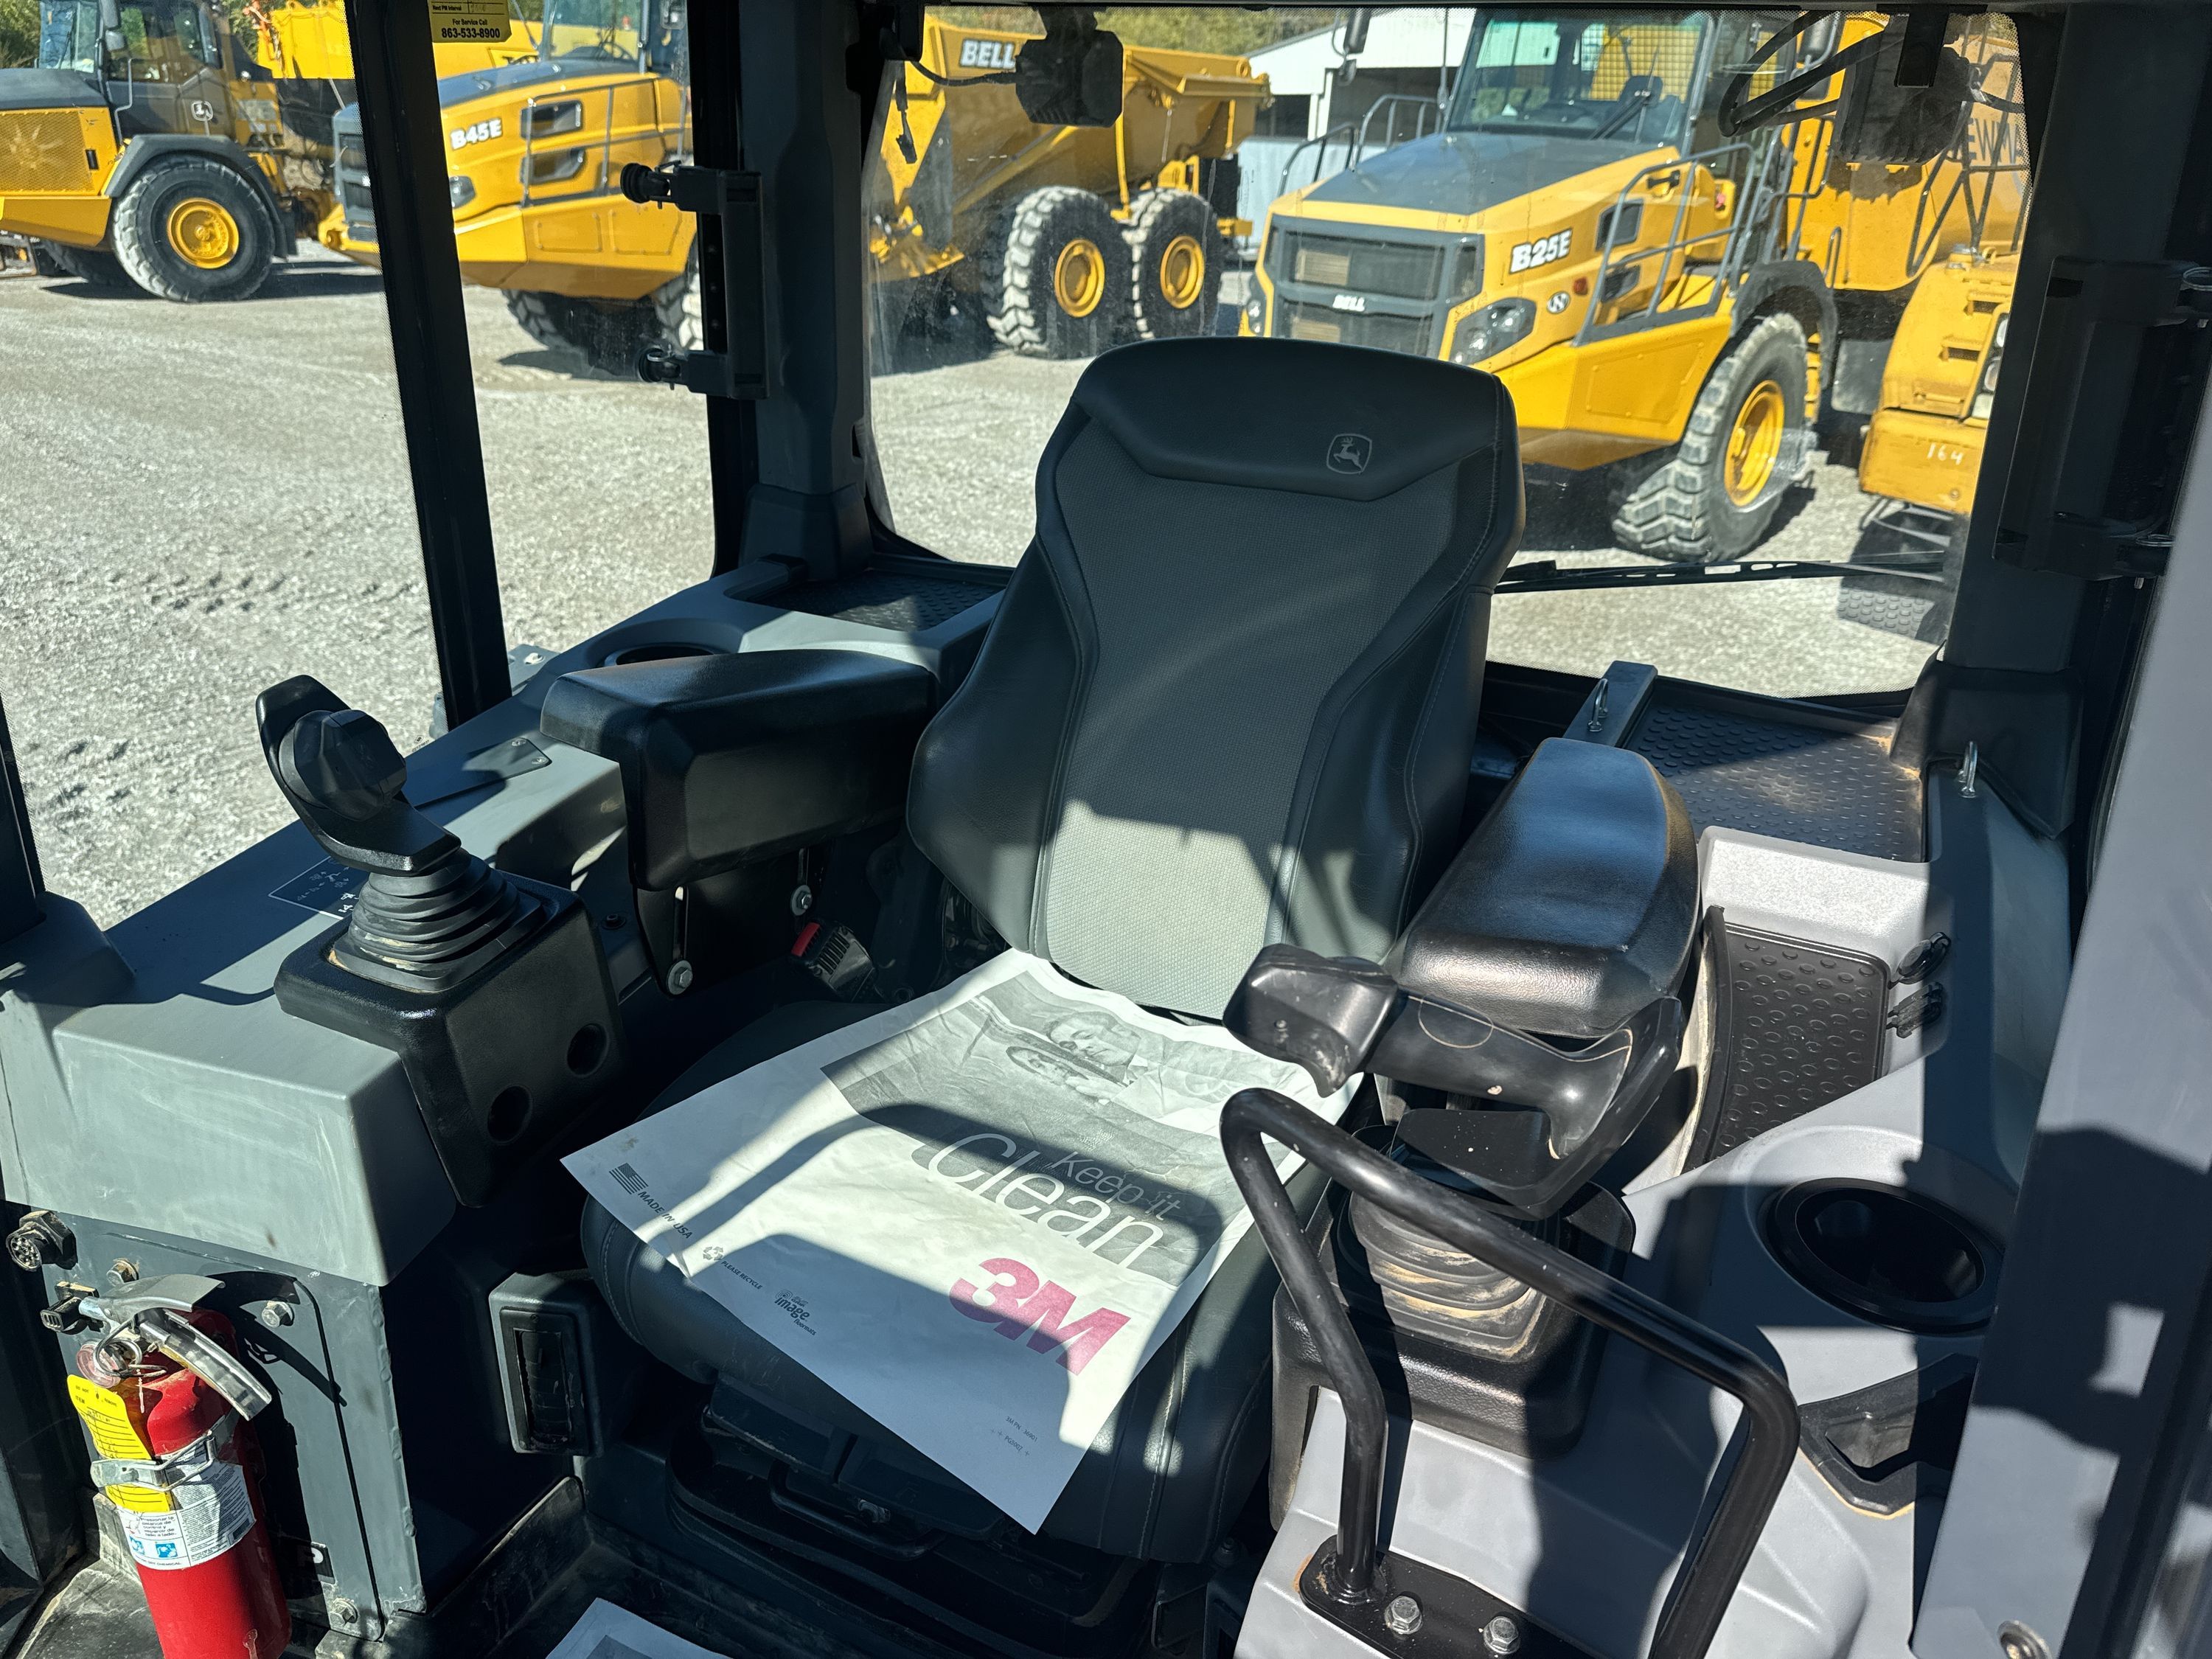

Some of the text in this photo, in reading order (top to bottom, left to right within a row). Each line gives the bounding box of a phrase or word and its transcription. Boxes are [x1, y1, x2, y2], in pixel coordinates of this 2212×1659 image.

[442, 27, 500, 38] 863-533-8900
[960, 39, 1016, 69] BELL
[451, 119, 502, 150] B45E
[1509, 228, 1573, 274] B25E
[1927, 442, 1964, 465] 164
[928, 1133, 1164, 1268] Clean
[1051, 1151, 1180, 1221] Keep it
[638, 1192, 692, 1239] MADE IN USA
[722, 1261, 763, 1290] PLEASE RECYCLE
[774, 1297, 810, 1321] image
[949, 1257, 1131, 1376] 3M
[793, 1318, 816, 1336] floormats
[1006, 1416, 1015, 1425] 3M
[1014, 1422, 1022, 1430] PN
